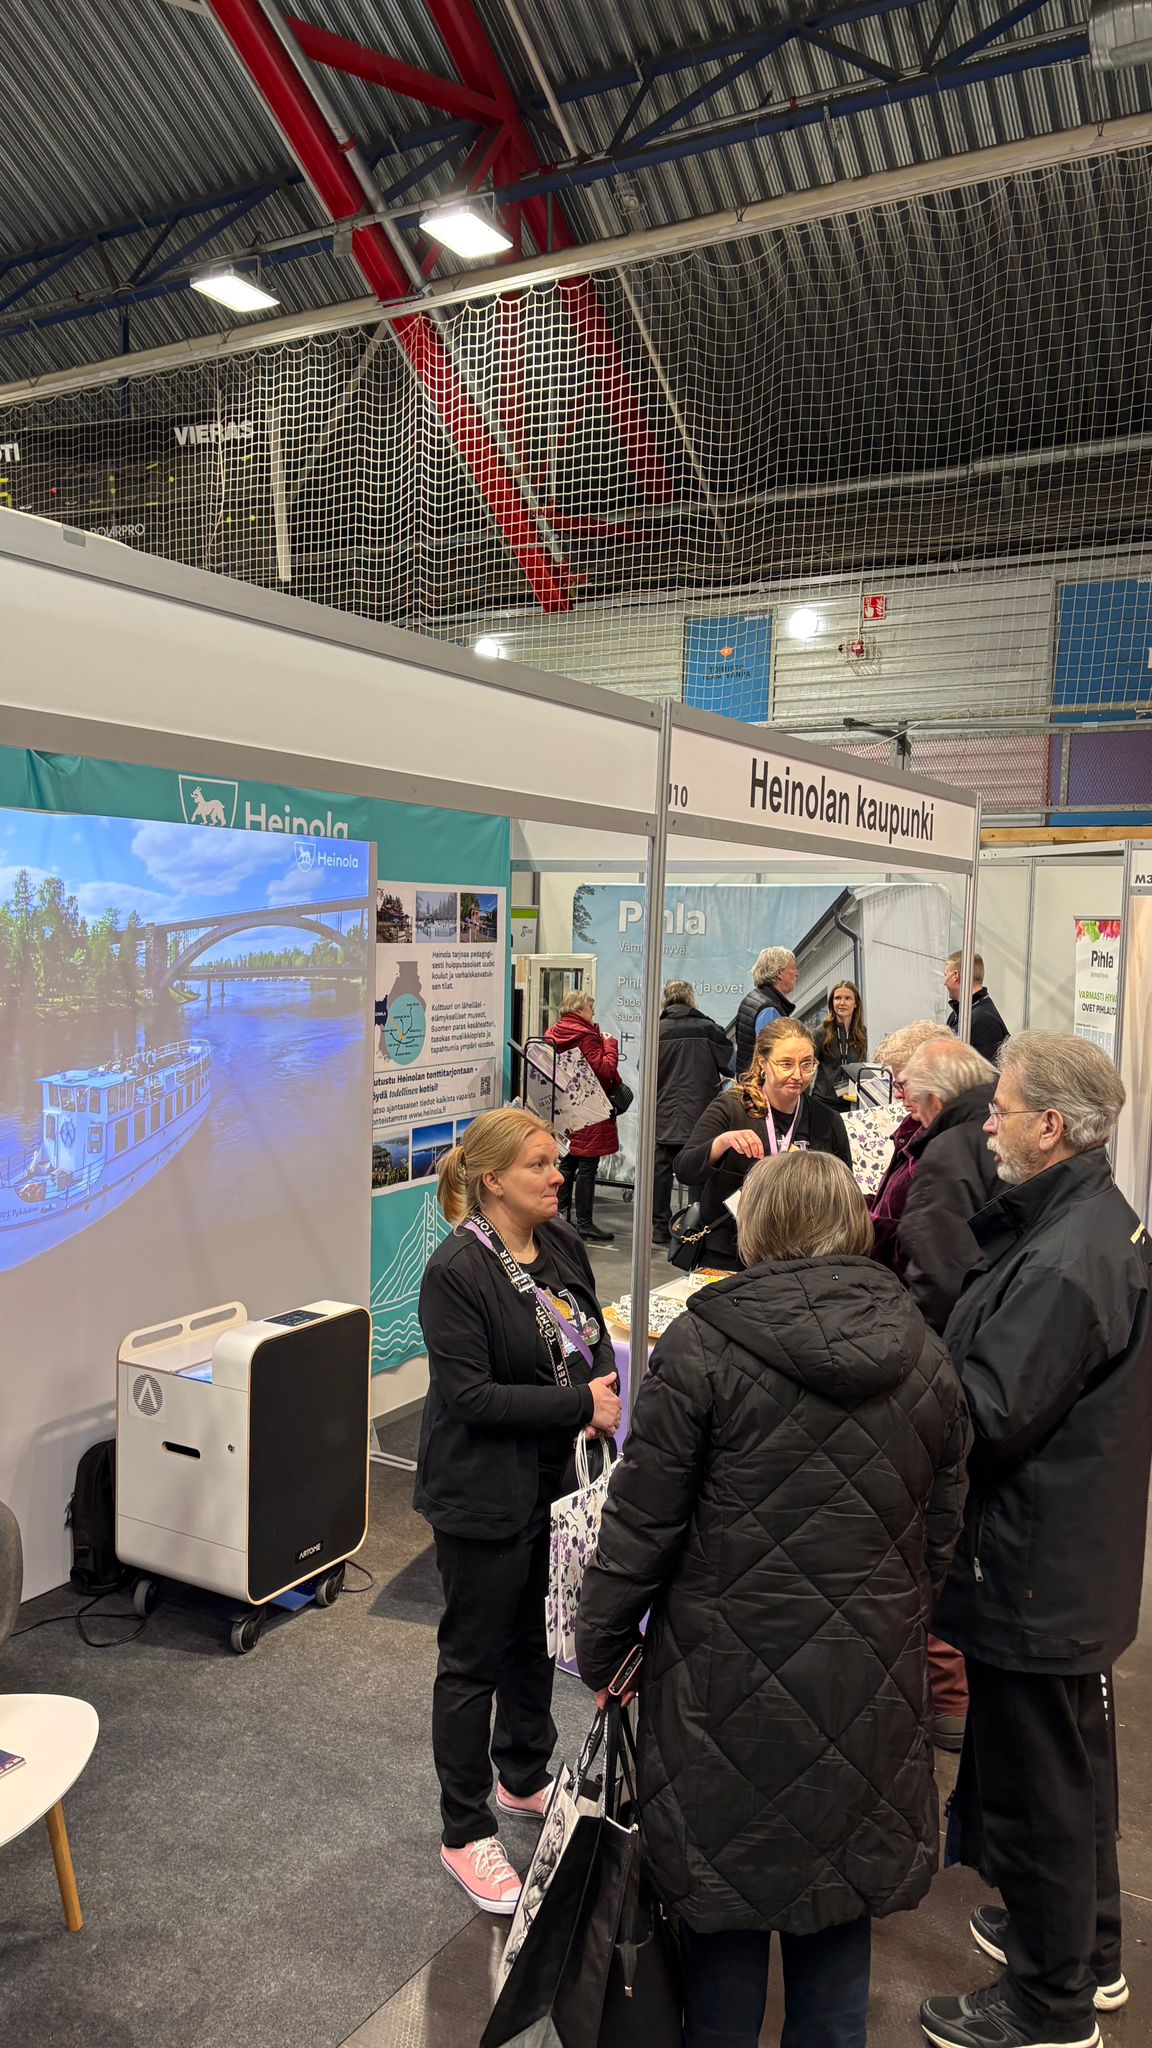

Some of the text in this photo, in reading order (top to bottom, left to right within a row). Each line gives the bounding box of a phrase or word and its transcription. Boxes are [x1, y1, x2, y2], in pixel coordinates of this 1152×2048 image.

[174, 420, 253, 445] VIERAS
[0, 443, 20, 462] TI
[91, 523, 144, 537] POLARPRO
[750, 758, 934, 844] Heinolan kaupunki
[245, 801, 348, 839] Heinola
[317, 851, 359, 868] Heinola
[618, 900, 706, 935] Pla
[452, 951, 469, 959] tarjoaa
[470, 950, 493, 959] pedagogi-
[618, 940, 643, 952] Varm
[445, 961, 481, 969] huipputasoiset
[1091, 950, 1114, 968] Pihla
[618, 976, 642, 988] Pihl
[699, 982, 711, 994] ja
[715, 982, 744, 994] ovet
[617, 996, 641, 1007] Suos
[1078, 990, 1104, 1001] VARMASTI
[432, 1003, 453, 1011] Kulttuuri
[461, 1001, 482, 1009] lähelläsi
[1082, 1003, 1095, 1012] OVET
[616, 1013, 641, 1022] suom
[431, 1024, 451, 1032] Suomen
[431, 1035, 450, 1043] tasokas
[451, 1032, 485, 1041] musiikkiopisto
[486, 1031, 491, 1039] ja
[431, 1044, 459, 1054] tapahtumia
[460, 1043, 476, 1052] ympäri
[374, 1076, 395, 1086] utustu
[398, 1072, 425, 1083] Heinolan
[427, 1067, 473, 1079] tonttitarjontaan
[373, 1083, 438, 1102] öydä todellinen kotisi!
[387, 1101, 418, 1113] ajantasaiset
[419, 1099, 435, 1108] tiedot
[436, 1096, 455, 1105] kaikista
[456, 1092, 476, 1102] vapaista
[373, 1107, 446, 1125] onteistamme www.heinola.fi
[536, 1301, 556, 1345] TOMM
[556, 1361, 568, 1387] GER
